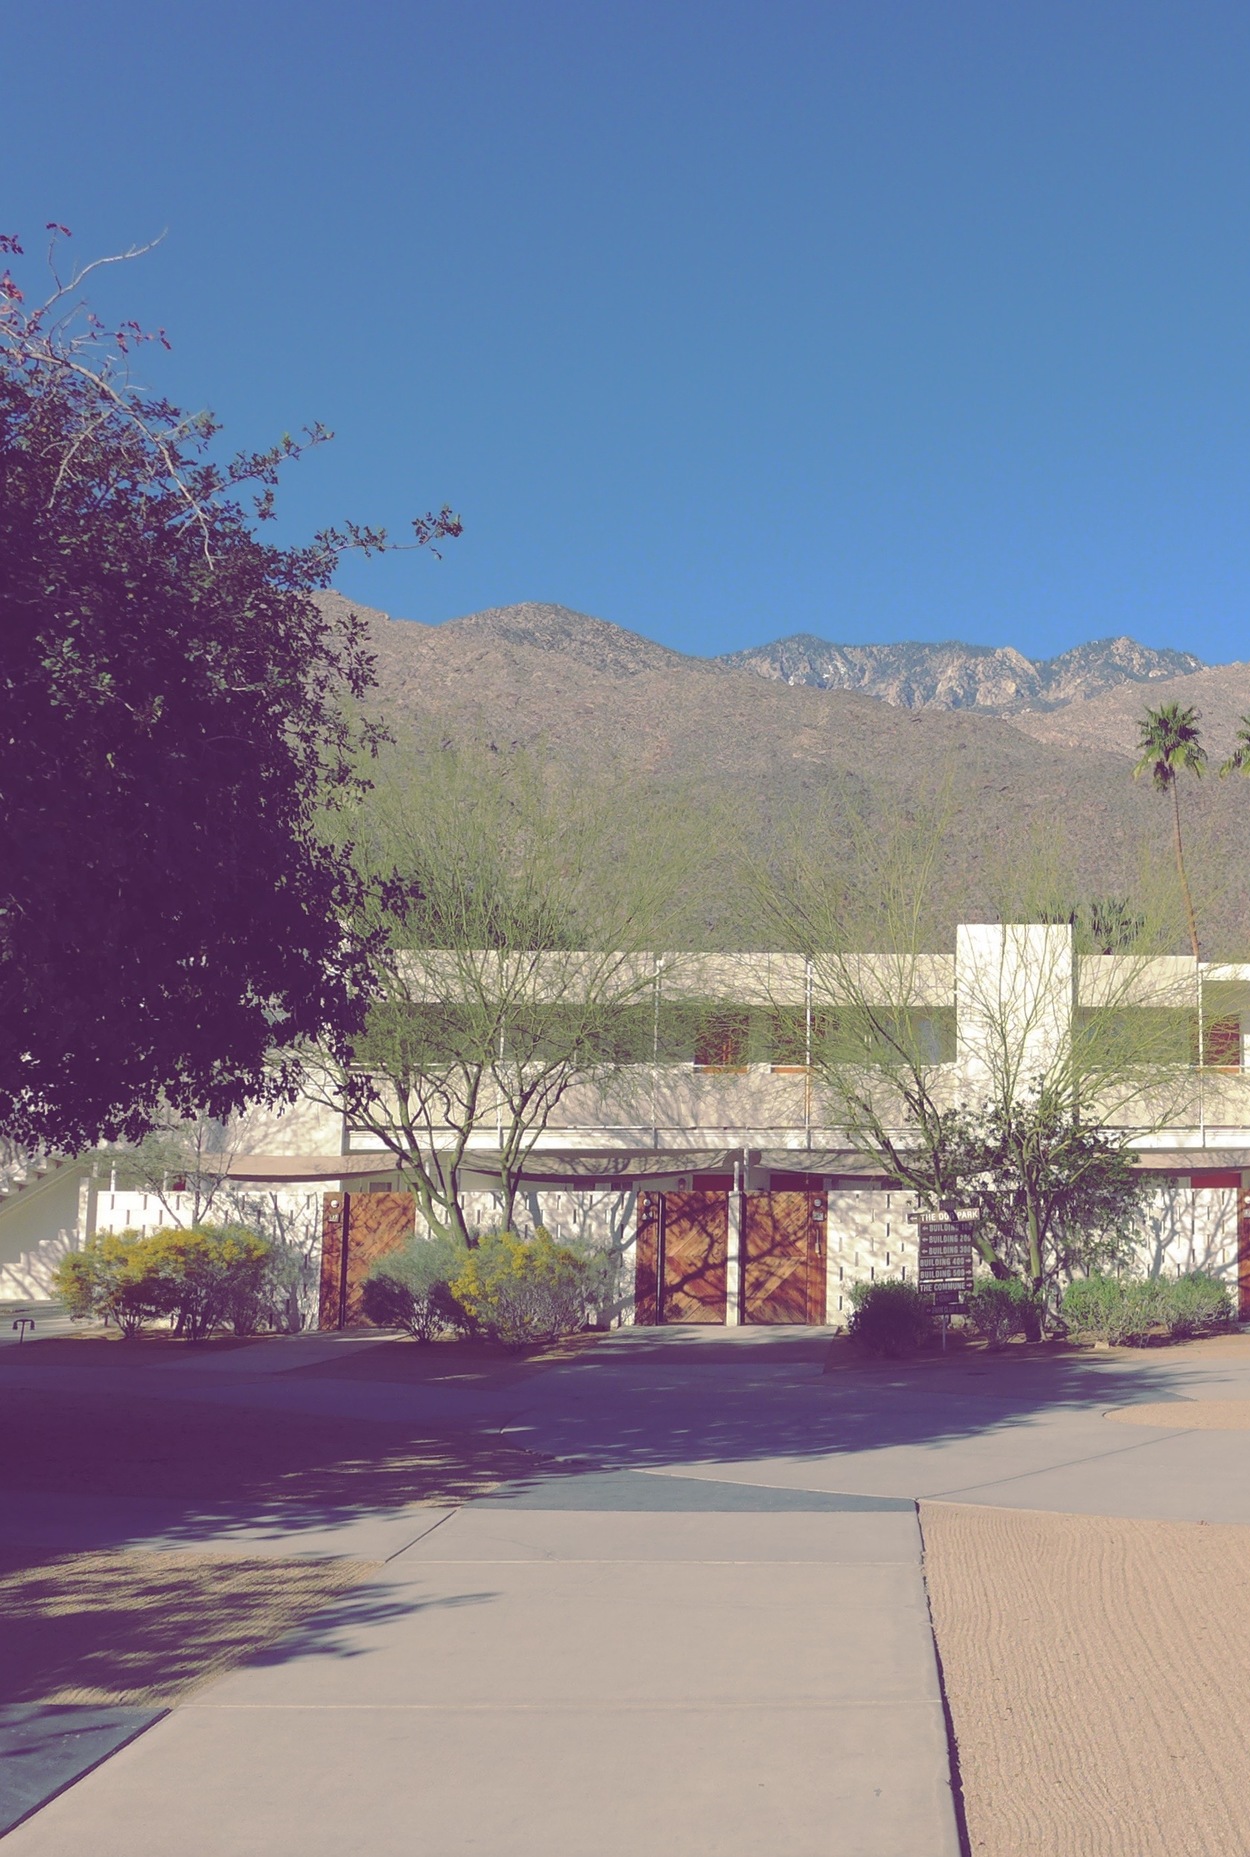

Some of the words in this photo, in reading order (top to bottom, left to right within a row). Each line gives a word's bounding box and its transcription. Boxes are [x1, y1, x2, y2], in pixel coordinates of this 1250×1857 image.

[920, 1213, 936, 1222] THE
[956, 1210, 978, 1219] PARK
[929, 1223, 959, 1232] BUILDING
[929, 1235, 959, 1243] BUILDING
[929, 1246, 958, 1255] BUILDING
[960, 1245, 971, 1253] 300
[920, 1258, 951, 1267] BUILDING
[952, 1257, 965, 1265] 400
[920, 1270, 951, 1279] BUILDING
[953, 1269, 965, 1277] 500
[919, 1284, 933, 1292] THE
[934, 1282, 966, 1291] COMMUNE
